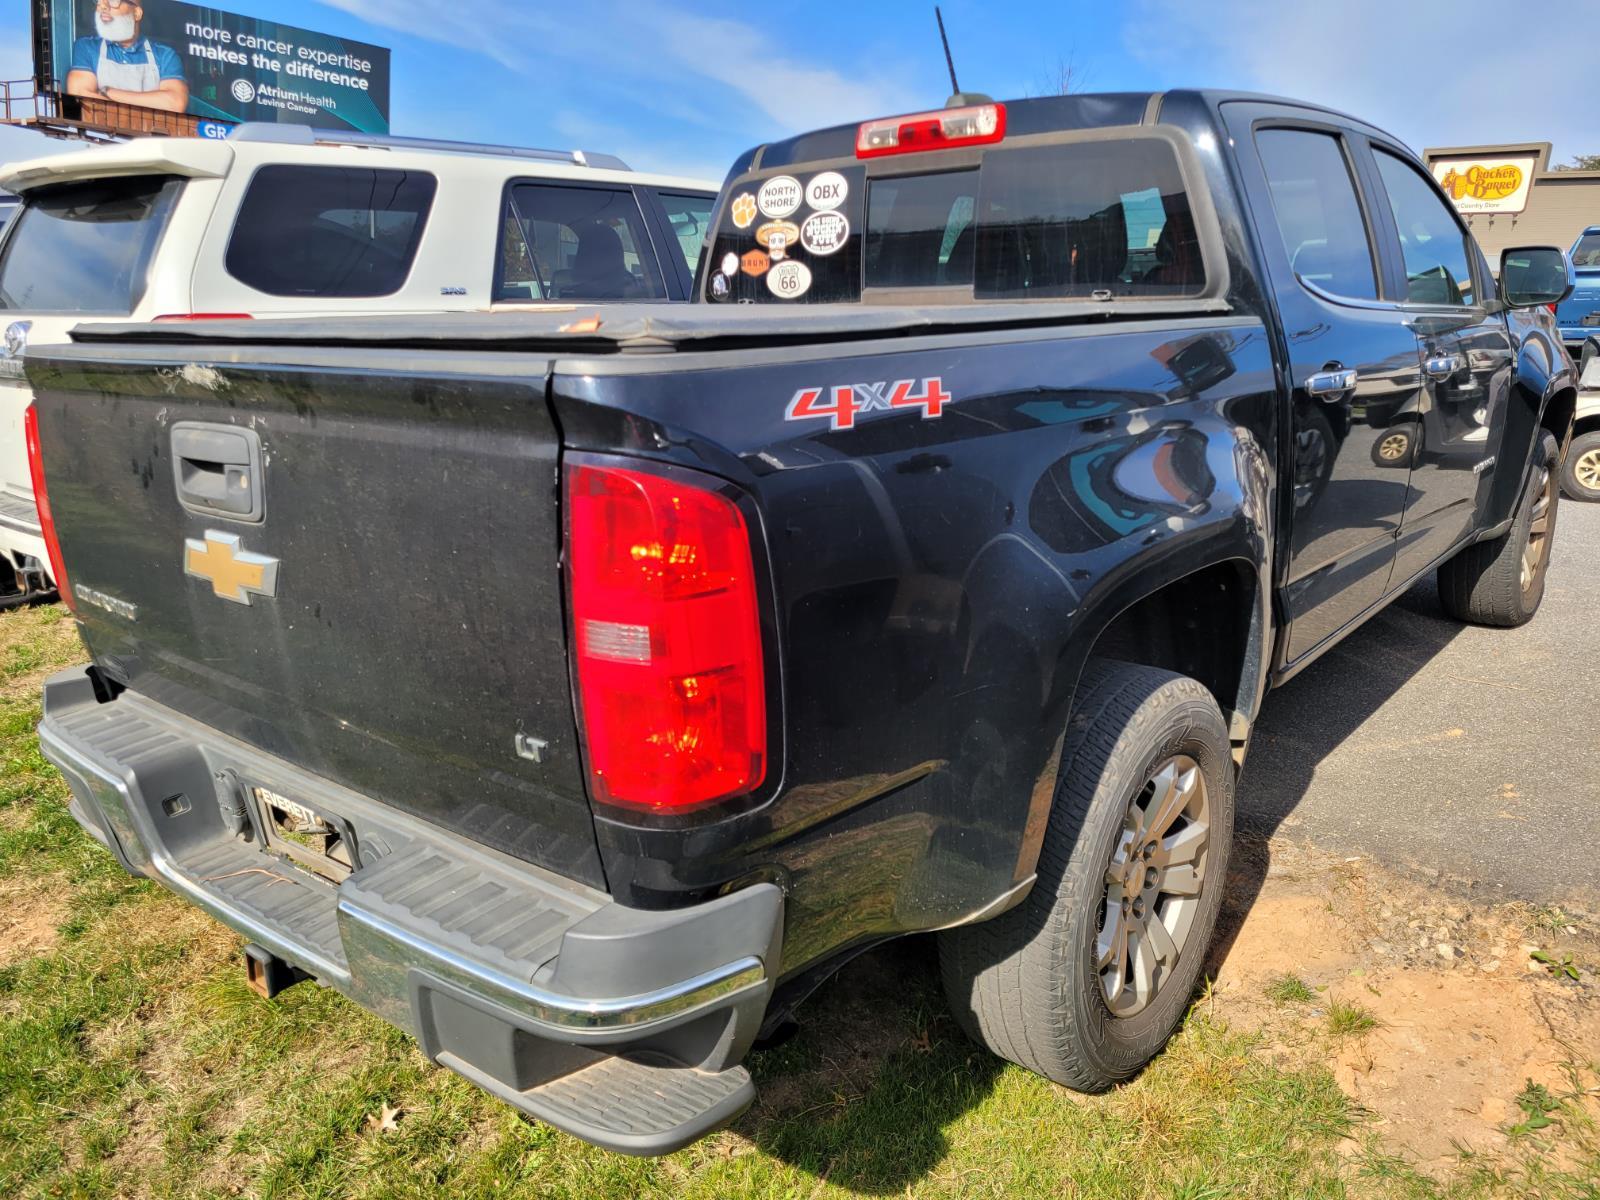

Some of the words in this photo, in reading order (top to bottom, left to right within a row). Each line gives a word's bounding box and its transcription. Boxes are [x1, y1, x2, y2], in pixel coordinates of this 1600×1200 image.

[185, 22, 232, 43] more
[236, 33, 293, 56] cancer
[297, 46, 371, 73] expertise
[189, 42, 248, 66] makes
[252, 53, 281, 72] the
[285, 60, 369, 90] difference
[257, 96, 286, 109] Levine
[287, 101, 318, 115] Cancer
[258, 83, 299, 102] Atrium
[300, 91, 337, 109] Health
[204, 123, 234, 140] GR
[1466, 166, 1516, 185] Cracker
[764, 186, 796, 197] NORTH
[813, 183, 840, 200] OBX
[1473, 178, 1516, 198] Barrel
[764, 197, 795, 209] SHORE
[781, 275, 797, 290] 66
[515, 733, 547, 763] LT
